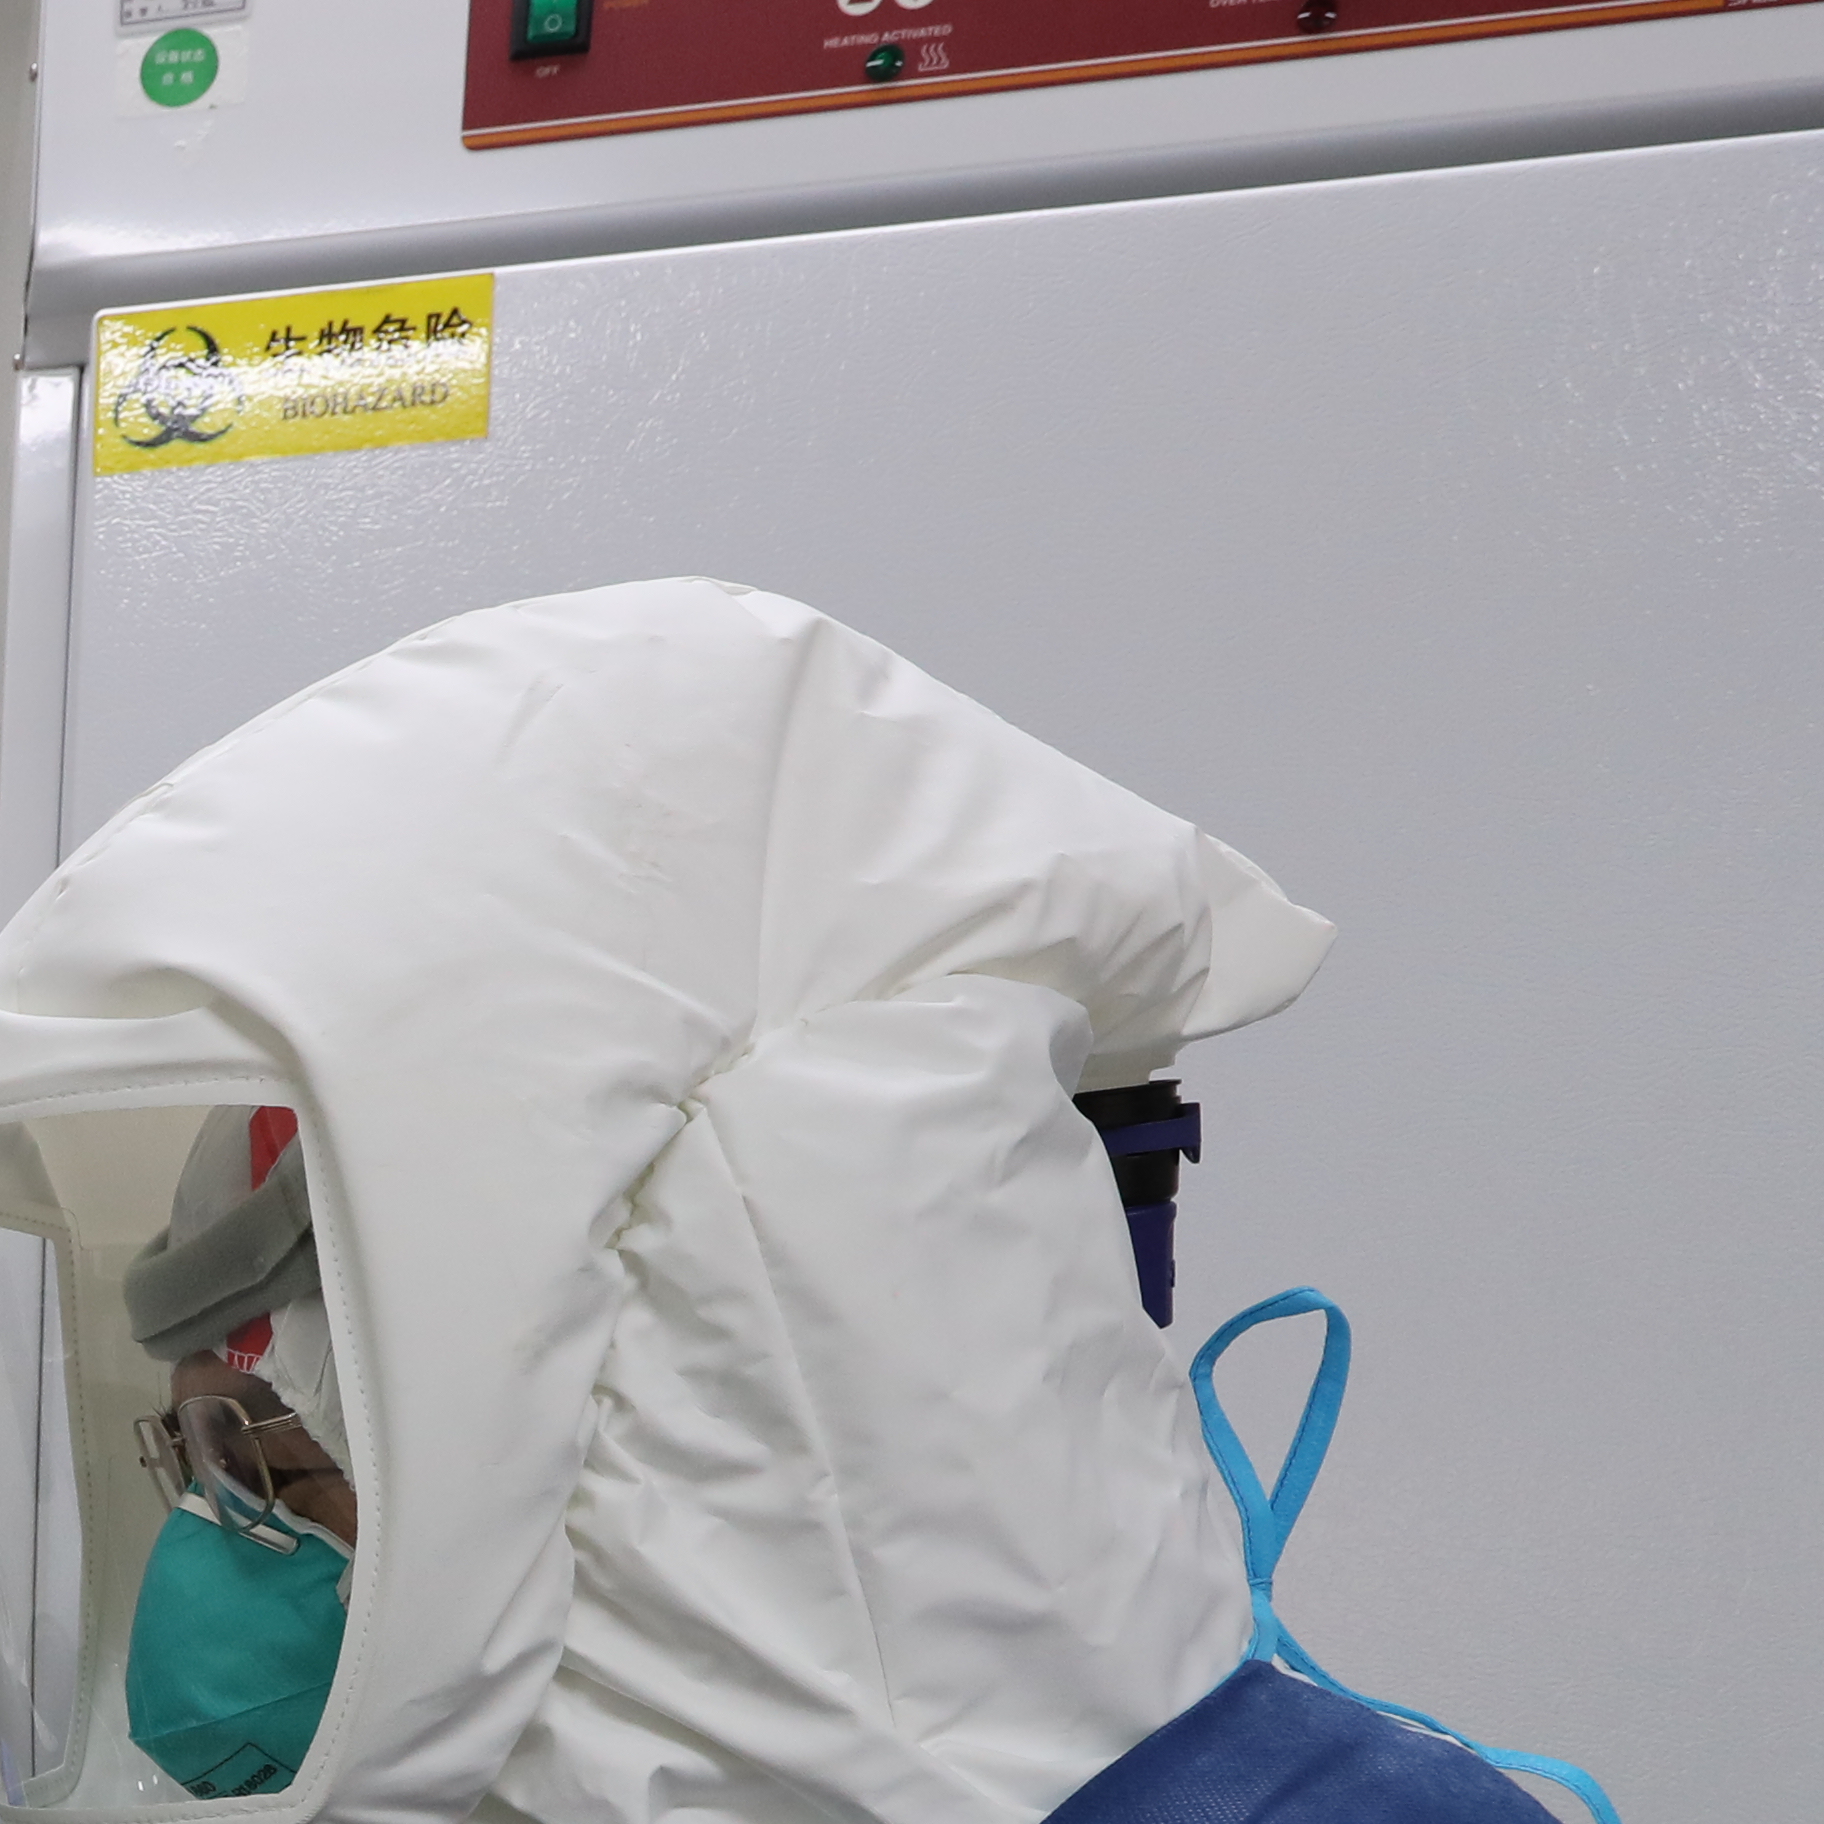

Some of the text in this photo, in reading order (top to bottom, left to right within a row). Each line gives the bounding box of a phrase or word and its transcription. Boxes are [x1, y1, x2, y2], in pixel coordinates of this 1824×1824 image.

[823, 24, 953, 49] HEATING ACTIVATED
[264, 306, 474, 369] 生物危险
[281, 382, 451, 422] BIOHAZARD
